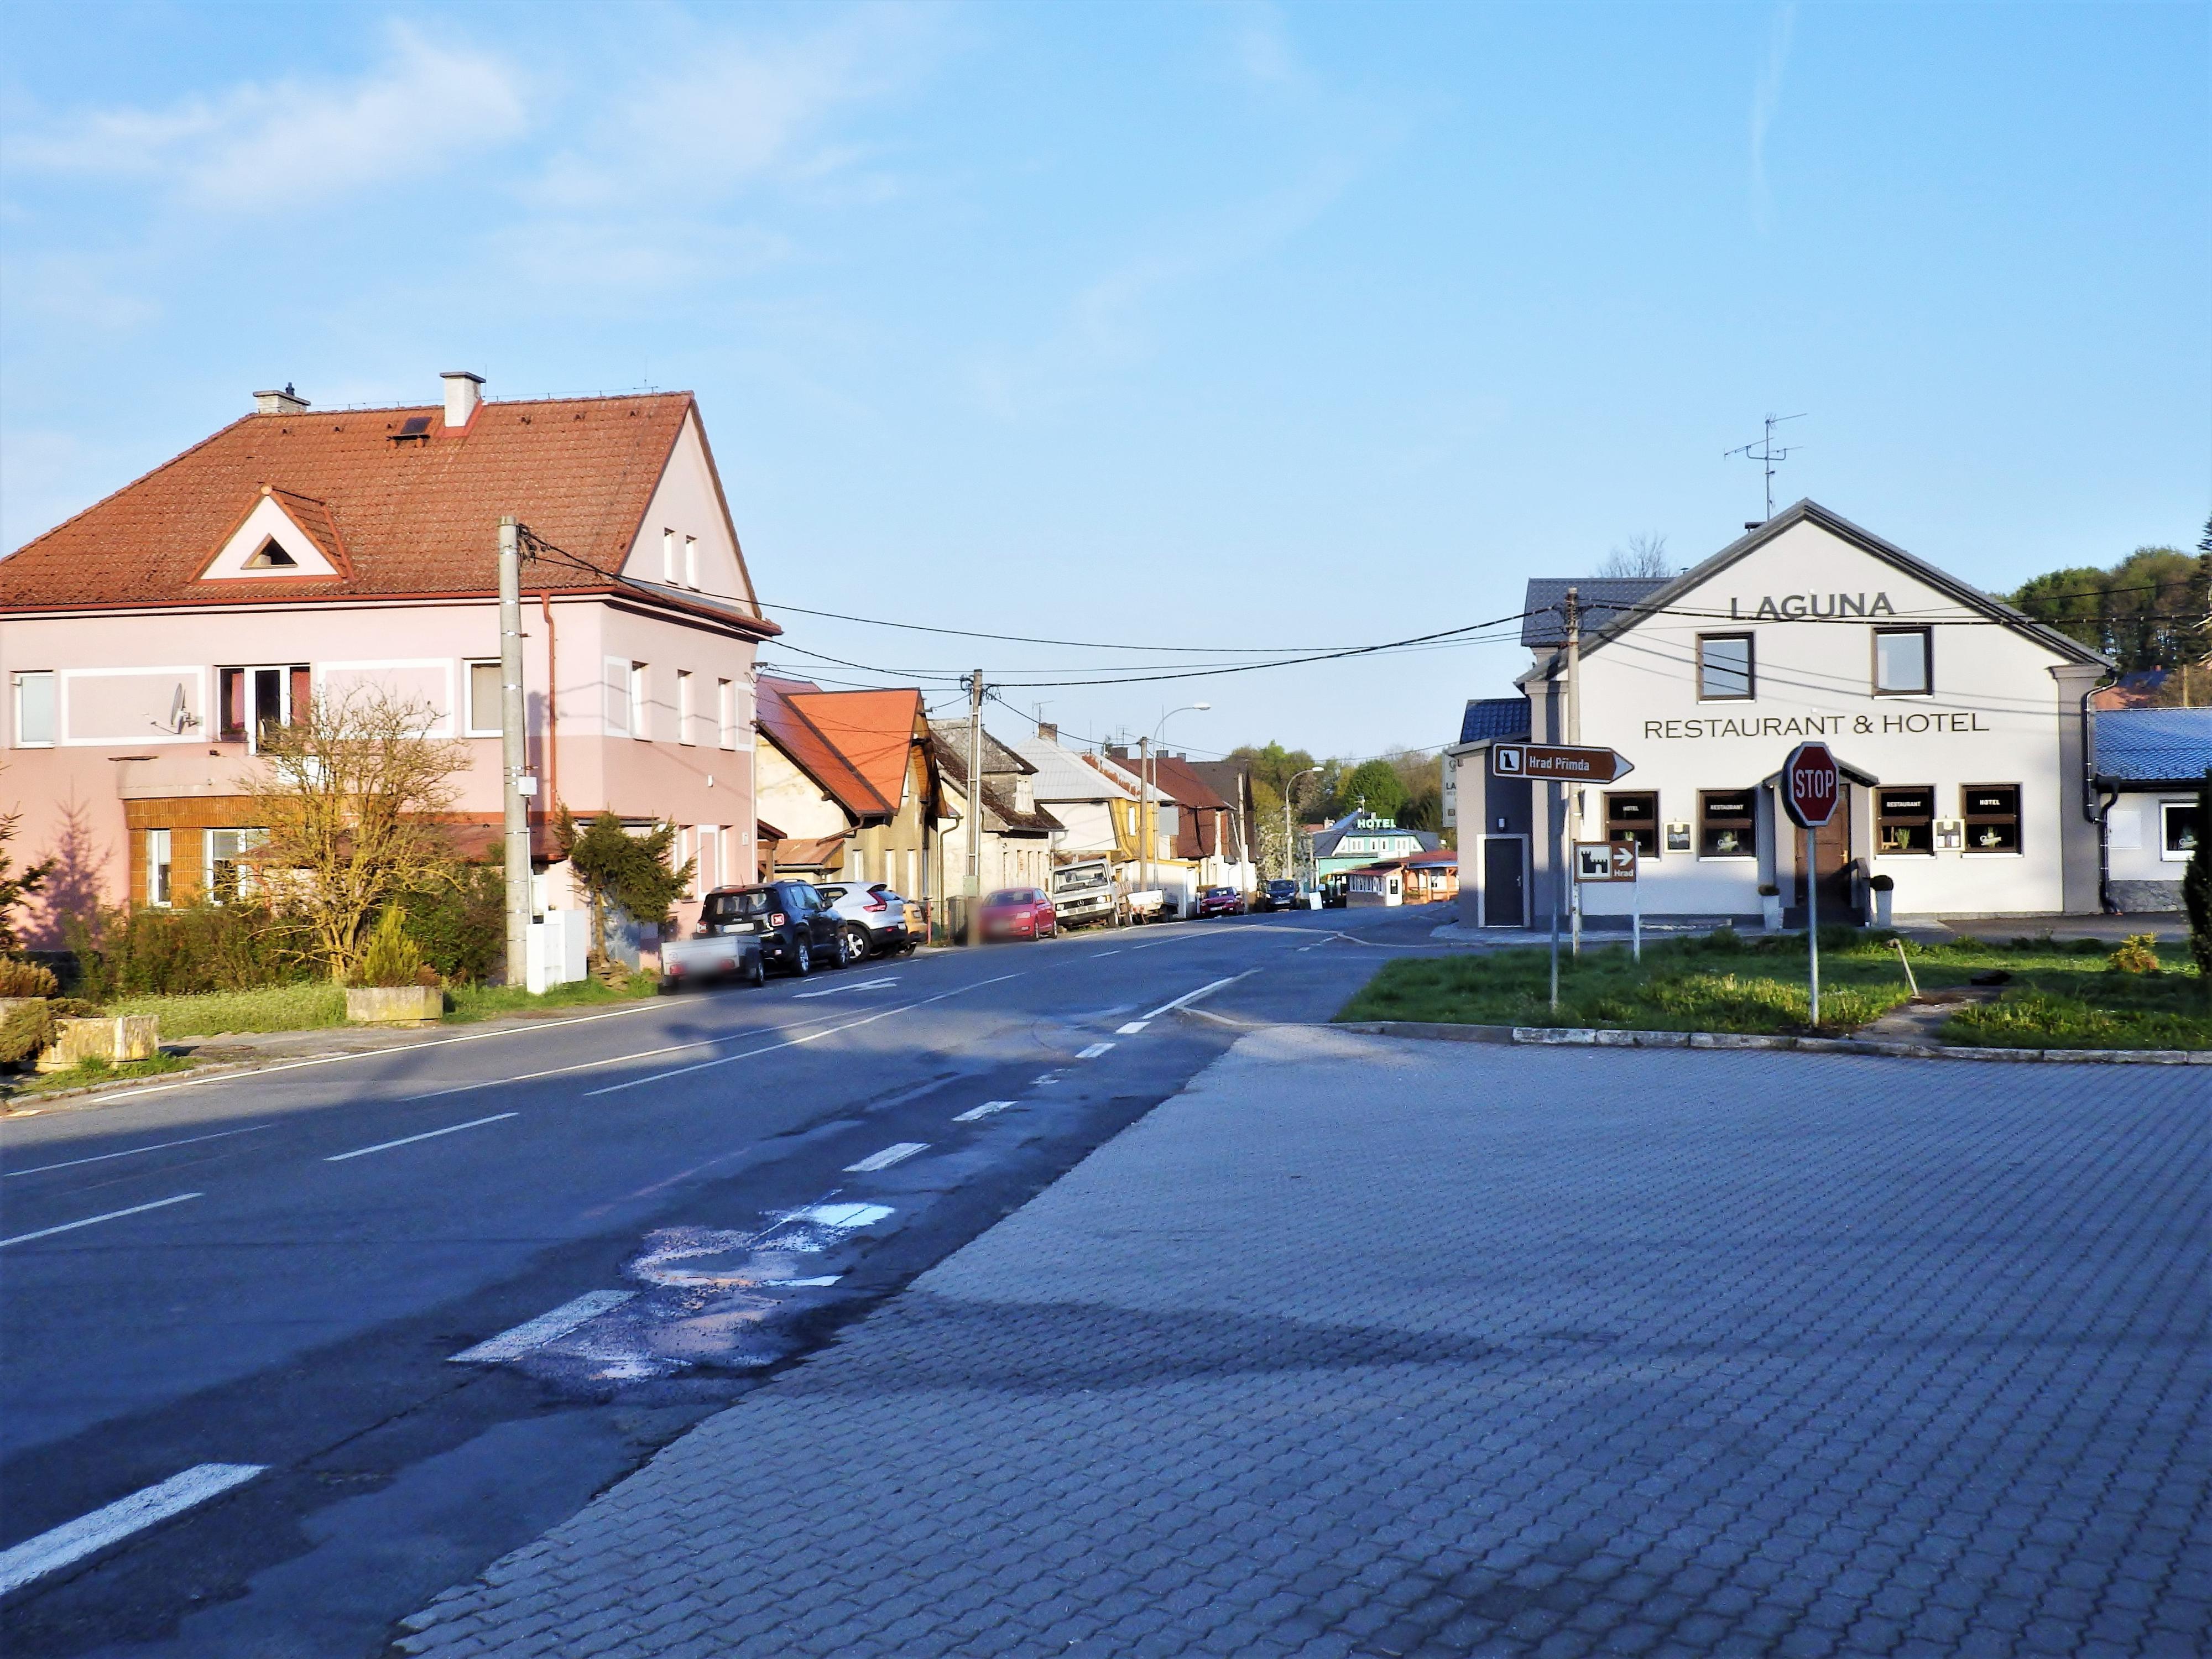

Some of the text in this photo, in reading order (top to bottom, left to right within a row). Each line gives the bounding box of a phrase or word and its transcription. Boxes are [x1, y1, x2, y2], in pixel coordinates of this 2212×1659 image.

[1731, 592, 1896, 620] LAGUNA
[1645, 713, 1990, 739] RESTAURANT & HOTEL
[1530, 755, 1590, 771] Hrad Přimda
[1796, 769, 1834, 798] STOP
[1357, 818, 1396, 828] HOTEL
[1614, 868, 1634, 877] Hrad
